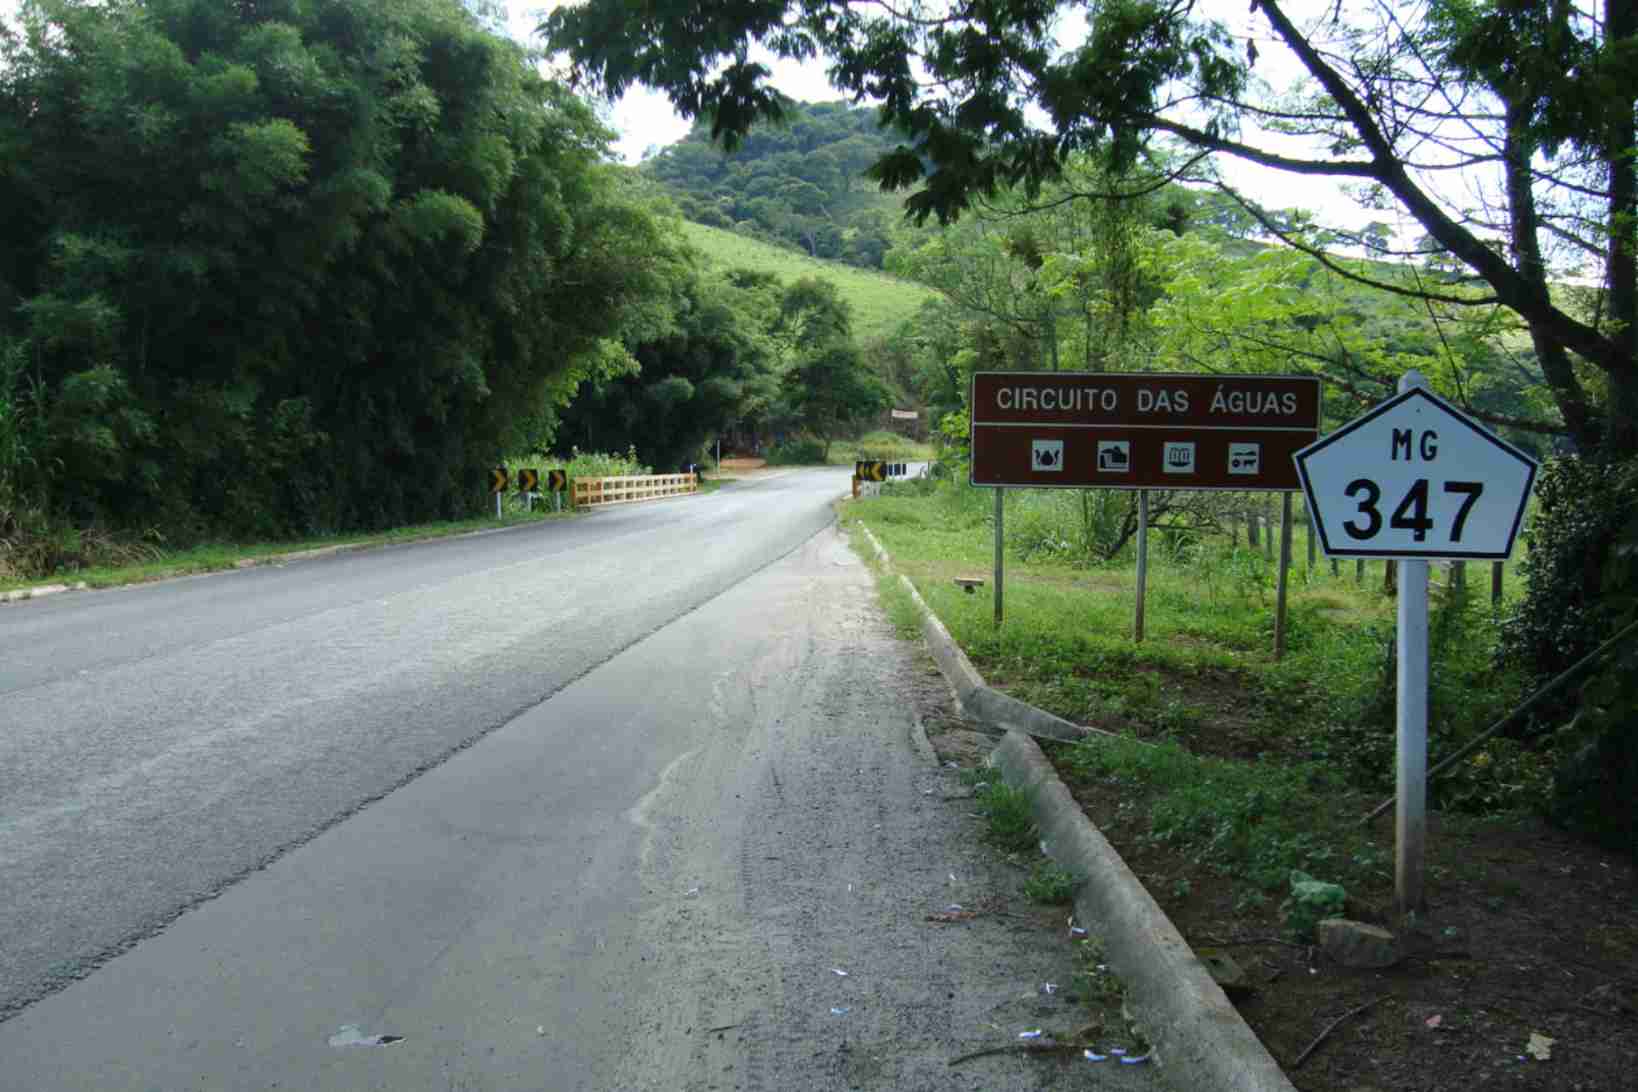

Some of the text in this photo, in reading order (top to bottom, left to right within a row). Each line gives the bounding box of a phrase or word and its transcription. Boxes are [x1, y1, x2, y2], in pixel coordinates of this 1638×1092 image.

[996, 384, 1298, 415] CIRCUITO DAS ÁGUAS
[1391, 428, 1438, 461] MG
[1343, 478, 1484, 542] 347
